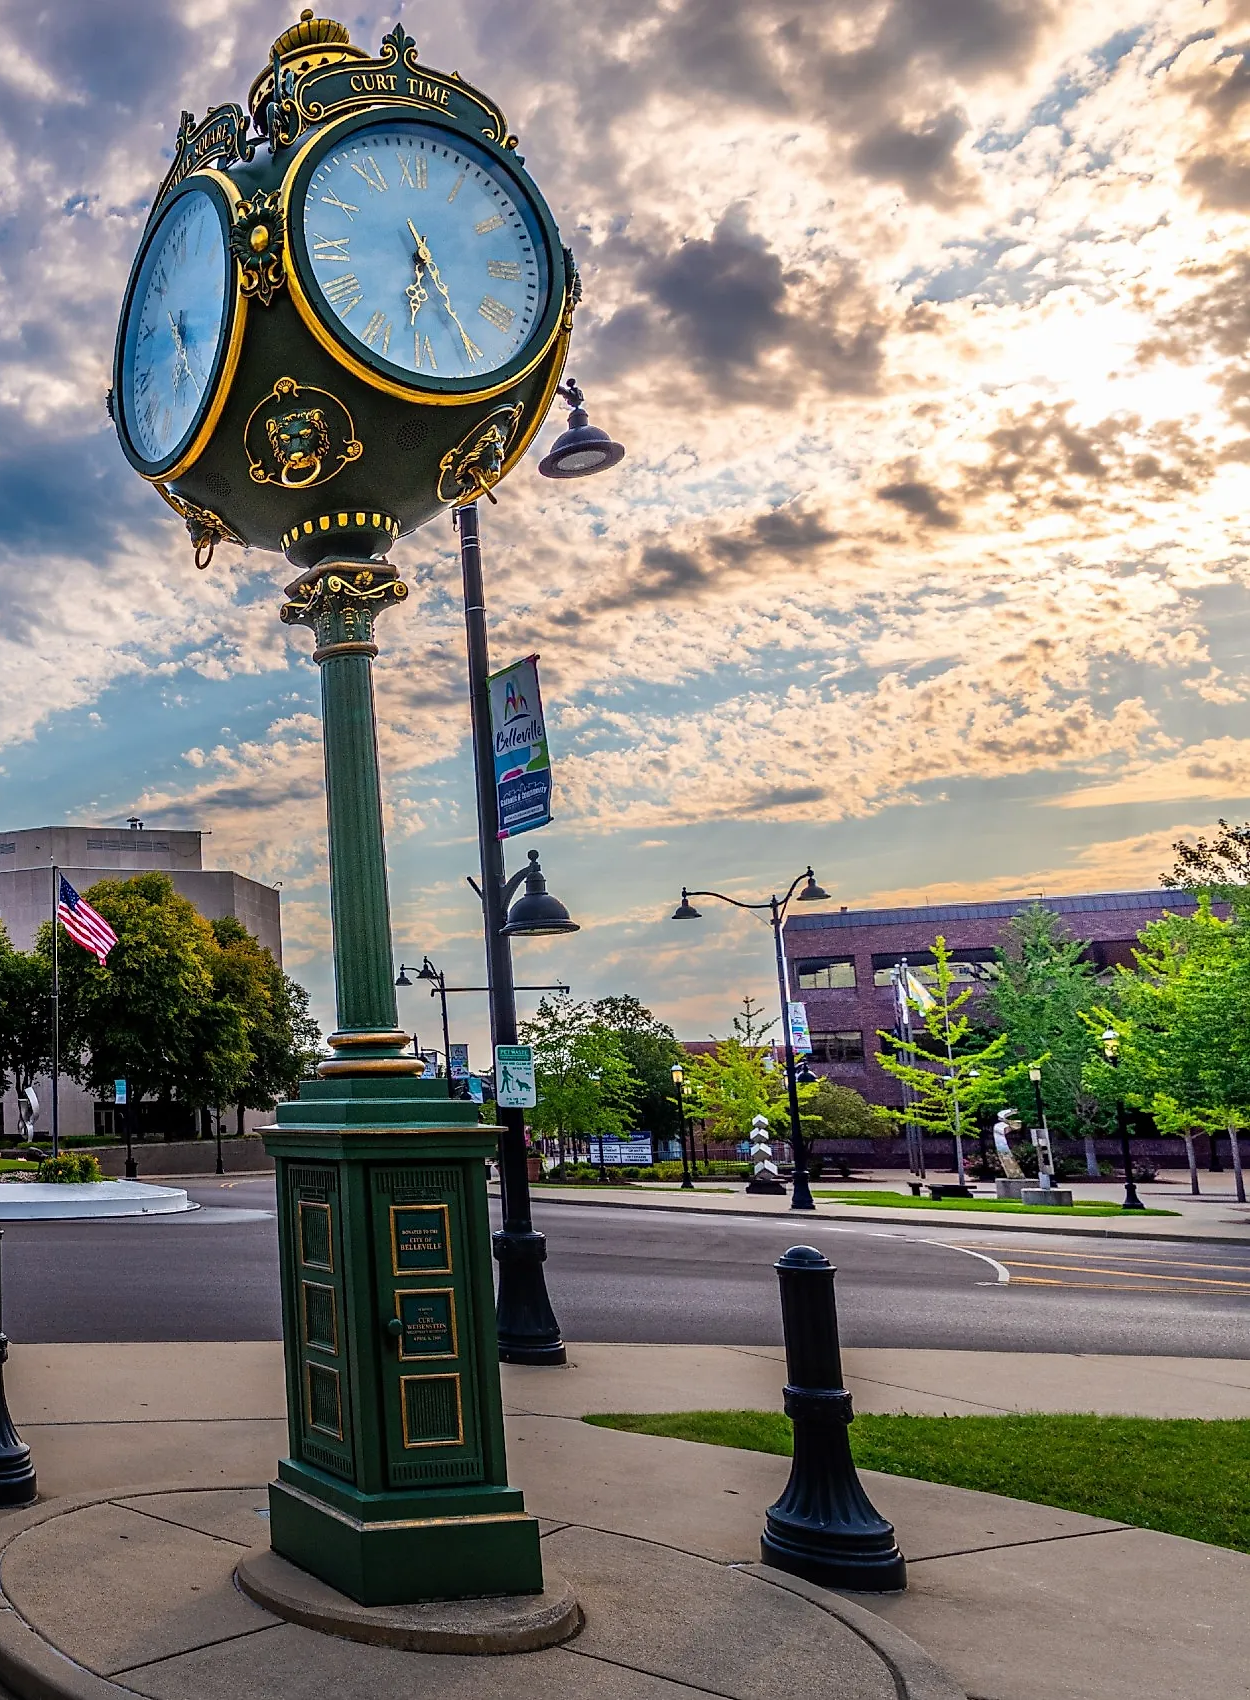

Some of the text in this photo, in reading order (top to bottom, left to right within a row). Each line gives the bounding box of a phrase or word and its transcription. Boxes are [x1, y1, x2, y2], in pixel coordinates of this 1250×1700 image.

[350, 74, 451, 106] CURT TIME
[194, 123, 229, 157] SQUARE
[350, 155, 390, 195] XI
[396, 151, 428, 189] XII
[321, 187, 360, 222] X
[313, 232, 350, 262] IX
[321, 272, 363, 318] VIII
[360, 308, 393, 355] VII
[414, 330, 439, 370] VI
[496, 719, 542, 753] Belleville
[400, 1243, 443, 1251] BELLEVILLE
